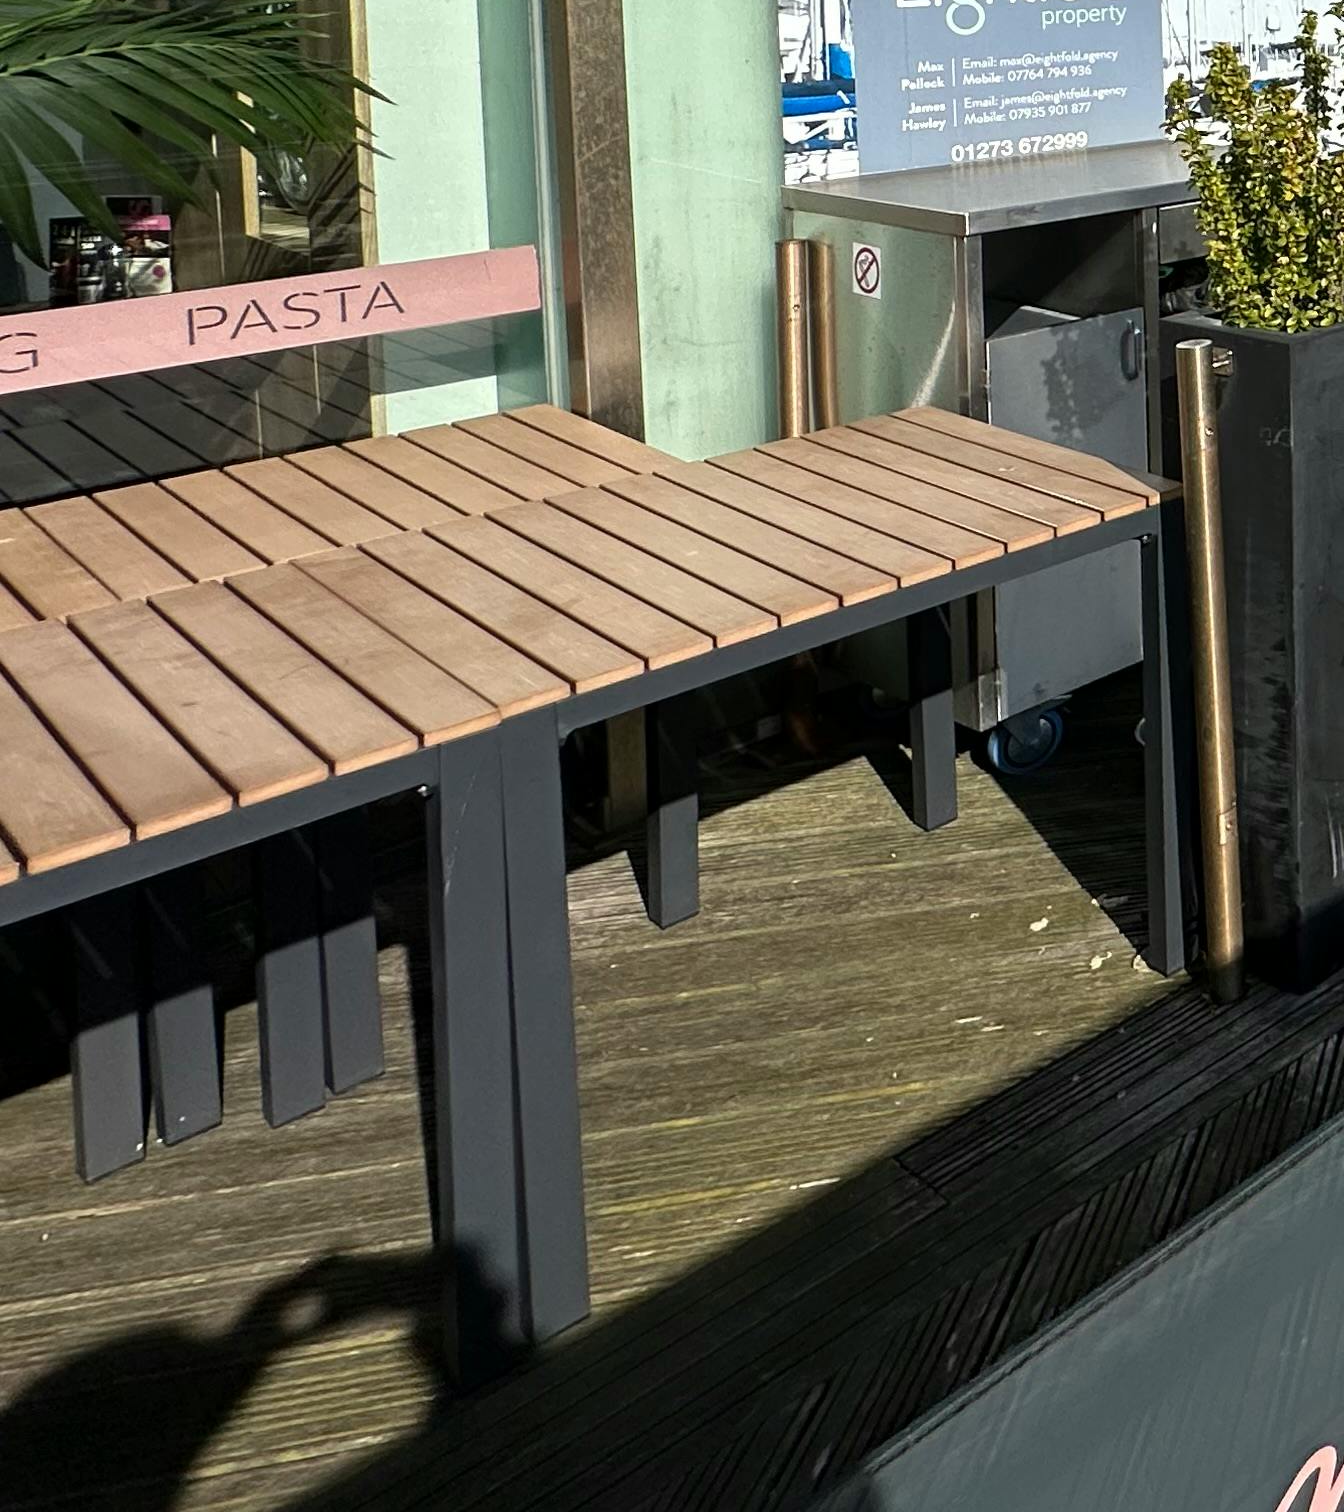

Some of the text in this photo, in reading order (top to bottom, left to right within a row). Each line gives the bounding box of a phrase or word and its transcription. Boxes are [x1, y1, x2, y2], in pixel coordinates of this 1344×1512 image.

[1041, 3, 1127, 30] property
[917, 61, 944, 73] Max
[962, 57, 997, 69] Email:
[962, 64, 1092, 85] Mobile: 07764 794 936
[908, 102, 946, 115] James
[964, 96, 998, 109] Email:
[1009, 107, 1045, 120] 07935
[1048, 104, 1068, 116] 901
[1071, 101, 1092, 114] 877
[951, 131, 1088, 162] 01273 672999
[187, 279, 406, 346] PASTA
